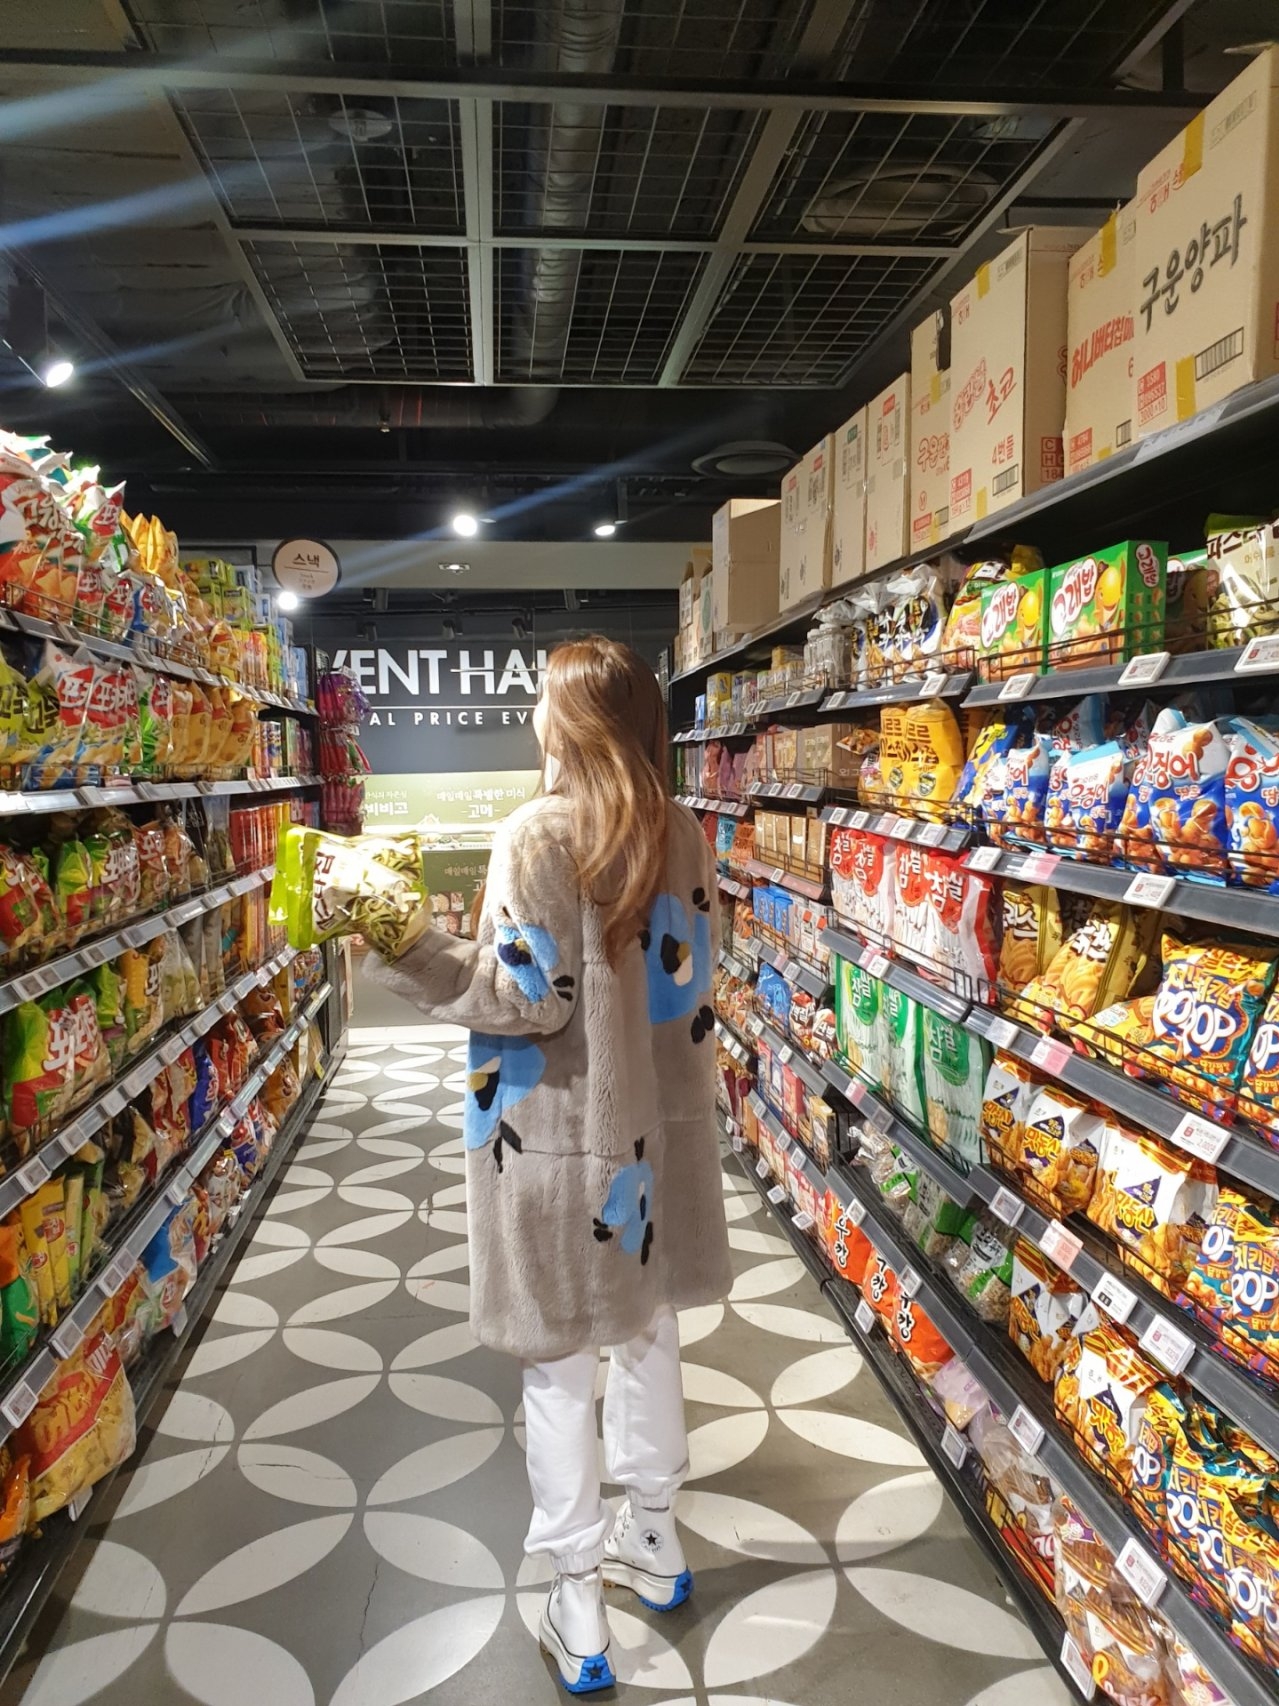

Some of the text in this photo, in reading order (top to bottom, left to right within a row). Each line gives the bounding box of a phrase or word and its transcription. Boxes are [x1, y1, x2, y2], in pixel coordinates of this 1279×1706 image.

[1140, 191, 1247, 335] 구운양파
[986, 367, 1017, 425] 초코
[292, 553, 320, 568] 스낵
[1207, 523, 1279, 560] 파스타
[1053, 562, 1097, 618] 고래밥
[415, 711, 484, 726] PRICE
[1023, 1127, 1061, 1164] 맛동산
[835, 1200, 851, 1268] 우깡
[1231, 1270, 1279, 1316] POP
